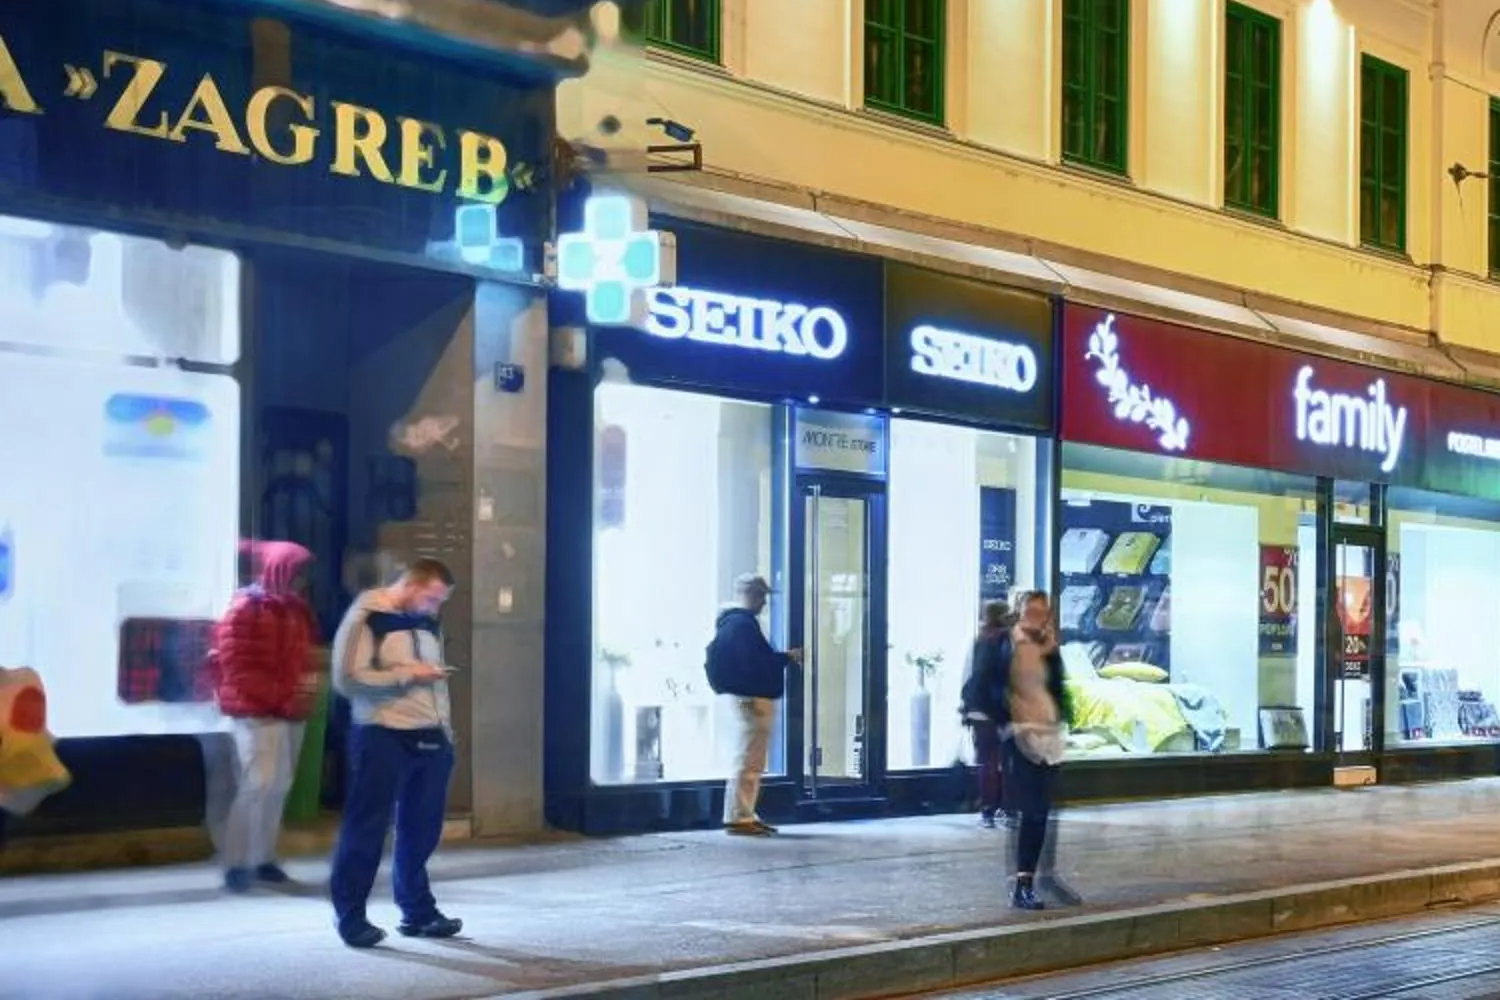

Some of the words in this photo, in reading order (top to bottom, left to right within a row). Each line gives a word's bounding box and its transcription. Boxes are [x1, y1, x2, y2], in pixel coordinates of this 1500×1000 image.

[646, 287, 846, 358] SEIKO
[911, 326, 1036, 392] SEIKO
[1294, 366, 1405, 471] family
